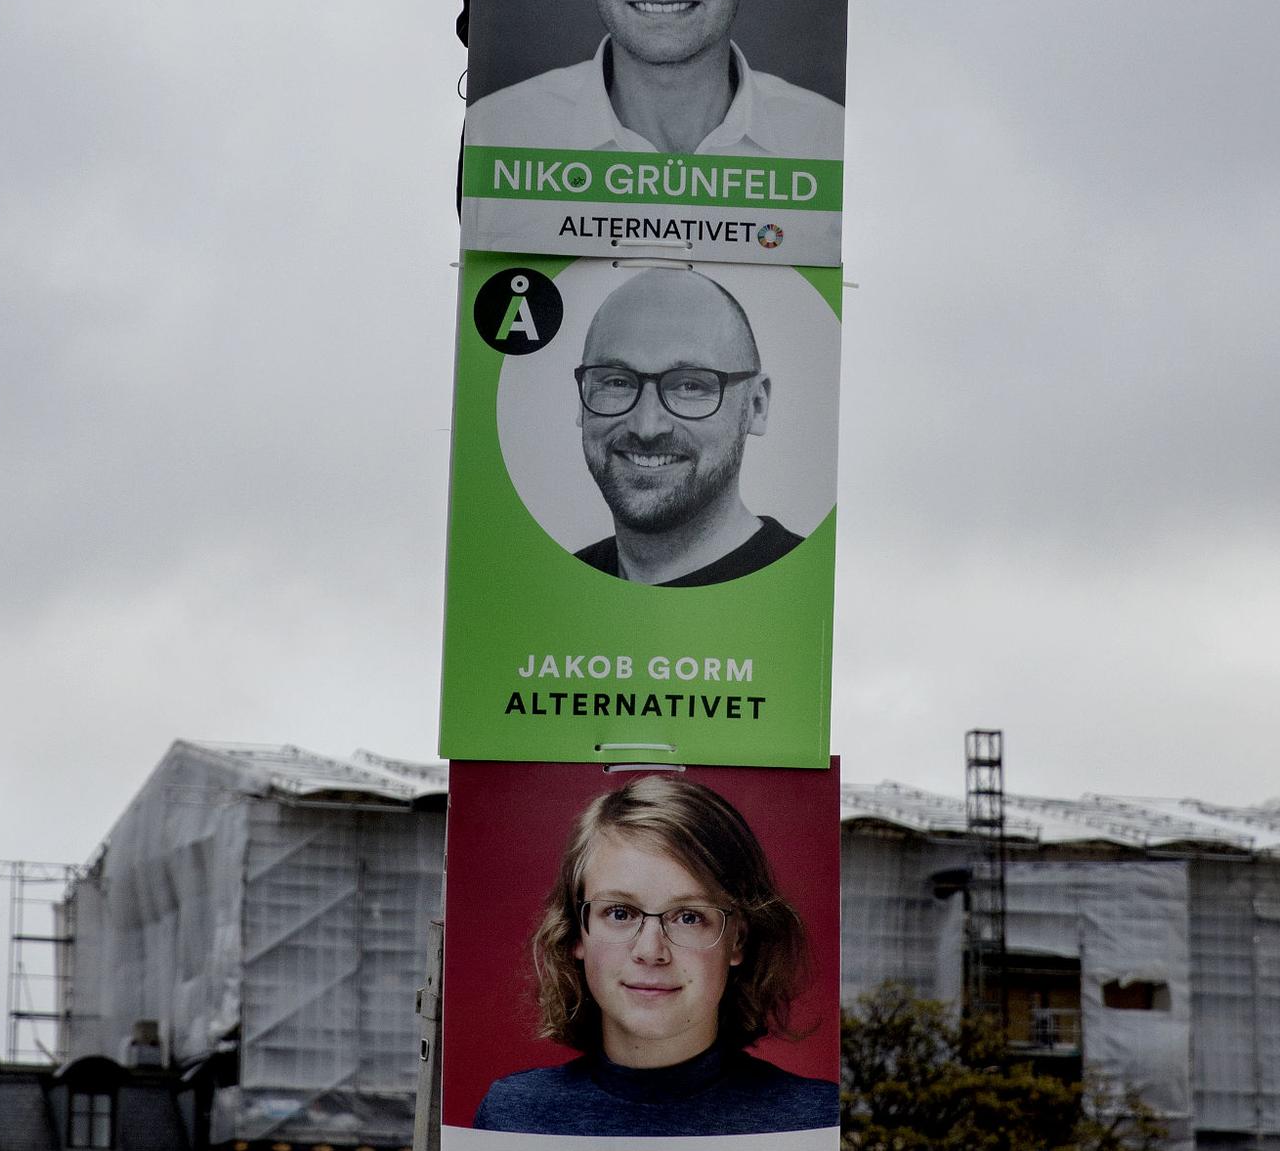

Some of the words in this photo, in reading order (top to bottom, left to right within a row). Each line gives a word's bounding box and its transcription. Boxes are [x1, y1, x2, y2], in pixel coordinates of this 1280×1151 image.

[494, 159, 592, 193] NIKO
[604, 158, 818, 201] GRÜNFELD
[559, 215, 756, 243] ALTERNATIVET
[495, 275, 540, 341] Å
[518, 655, 633, 679] JAKOB
[647, 656, 753, 682] GORM
[504, 691, 766, 719] ALTERNATIVET
